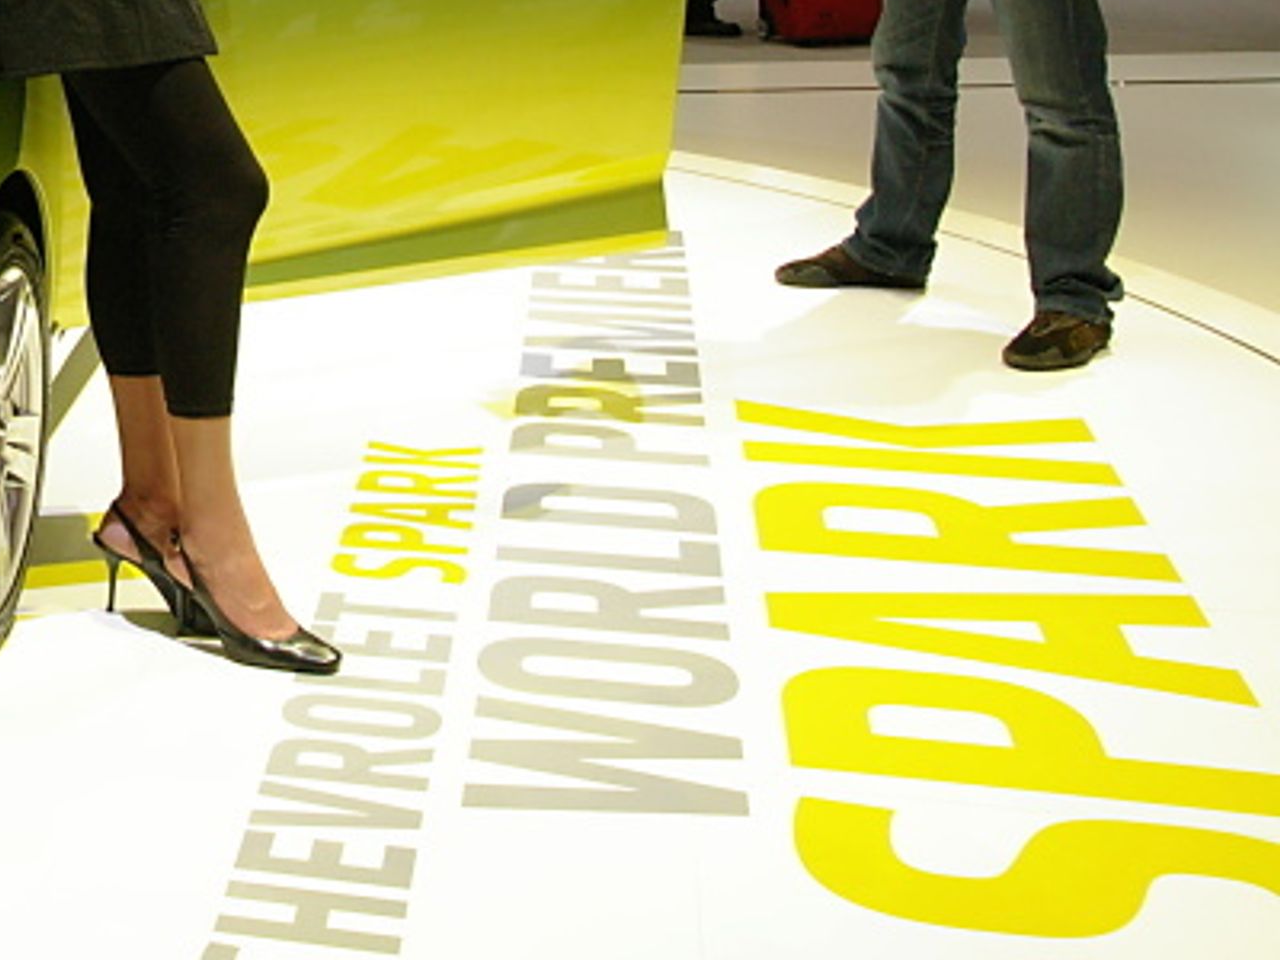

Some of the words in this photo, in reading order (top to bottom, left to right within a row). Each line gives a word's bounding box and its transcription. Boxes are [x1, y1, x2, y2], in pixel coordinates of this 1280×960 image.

[200, 591, 459, 960] HEVROLET
[330, 440, 485, 585] SPARK
[461, 482, 751, 816] WORLD
[734, 399, 1280, 938] SPARK
